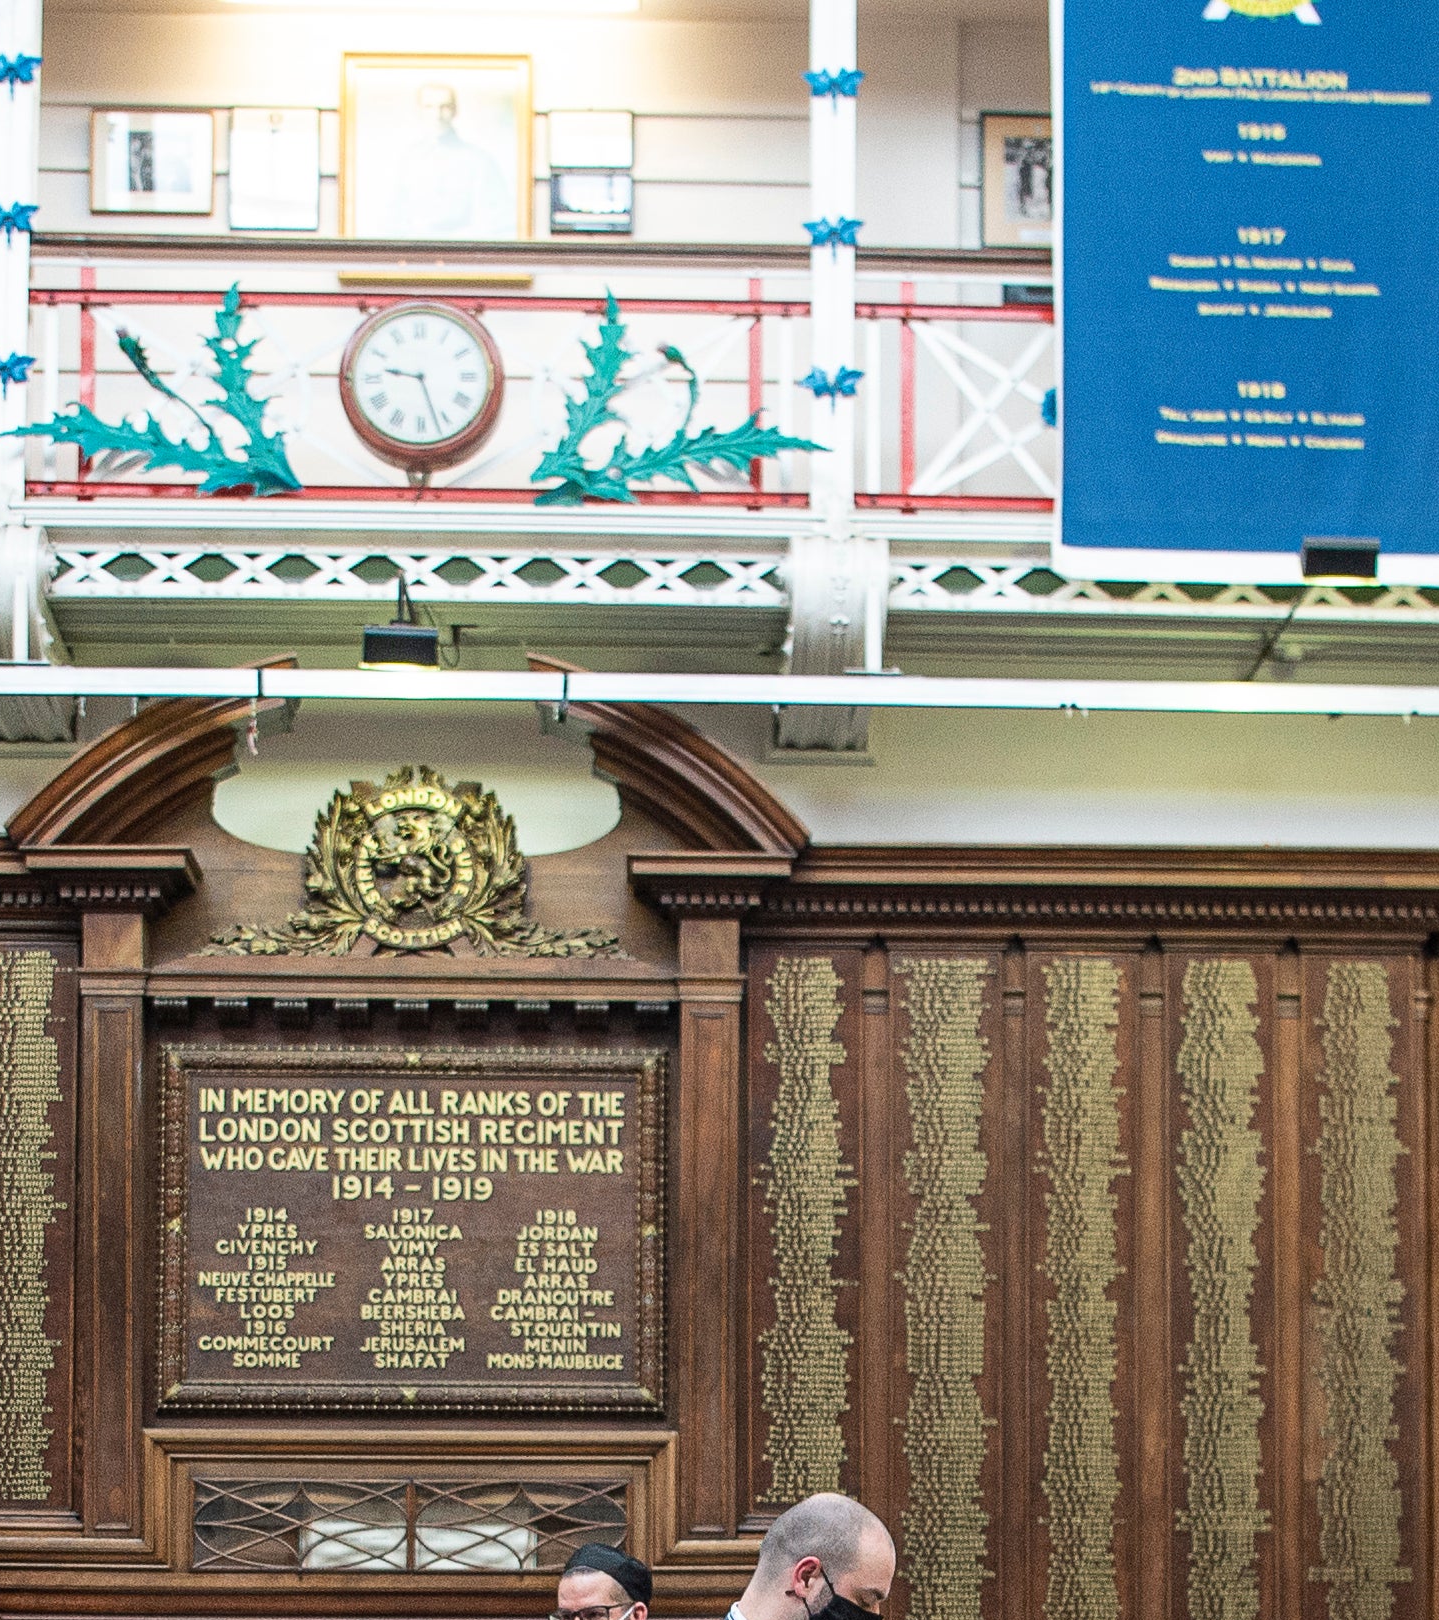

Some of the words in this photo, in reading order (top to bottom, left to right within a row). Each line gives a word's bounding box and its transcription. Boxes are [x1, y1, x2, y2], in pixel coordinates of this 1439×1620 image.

[366, 788, 463, 817] LONDON
[365, 919, 463, 946] SCOTTISH
[199, 1090, 226, 1114] IN
[233, 1090, 344, 1114] MEMORY
[349, 1090, 383, 1115] OF
[389, 1091, 434, 1115] ALL
[444, 1091, 530, 1116] RANKS
[536, 1092, 570, 1116] OF
[579, 1092, 625, 1117] THE
[199, 1119, 321, 1142] LONDON
[332, 1119, 470, 1144] SCOTTISH
[479, 1120, 624, 1145] REGIMENT
[201, 1148, 262, 1171] WHO
[268, 1148, 329, 1171] GAVE
[335, 1148, 401, 1171] THEIR
[408, 1149, 476, 1172] LIVES
[482, 1149, 511, 1172] IN
[518, 1149, 558, 1173] THE
[567, 1150, 623, 1174] WAR
[332, 1176, 395, 1199] 1914
[432, 1176, 494, 1200] 1919
[246, 1208, 288, 1223] 1914
[392, 1208, 433, 1224] 1917
[536, 1209, 577, 1225] 1918
[237, 1224, 298, 1239] YPRES
[364, 1224, 463, 1240] SALONICA
[516, 1226, 598, 1242] JORDAN
[216, 1239, 318, 1255] GIVENCHY
[388, 1241, 439, 1256] VIMY
[518, 1242, 540, 1258] ES
[546, 1242, 593, 1258] SALT
[247, 1255, 287, 1271] 1915
[381, 1257, 446, 1273] ARRAS
[515, 1258, 537, 1274] EL
[544, 1258, 598, 1274] HAUD
[199, 1272, 250, 1287] NEUVE
[253, 1272, 336, 1287] CHAPPELLE
[383, 1273, 444, 1289] YPRES
[524, 1274, 589, 1290] ARRAS
[216, 1288, 318, 1303] FESTUBERT
[368, 1289, 458, 1304] CAMBRAI
[498, 1289, 615, 1307] DRANOUTRE
[240, 1304, 296, 1319] LOOS
[360, 1305, 466, 1321] BEERSHEBA
[490, 1306, 580, 1321] CAMBRAI
[246, 1321, 286, 1335] 1916
[380, 1321, 446, 1336] SHERIA
[511, 1323, 621, 1339] ST.QUENTIN
[199, 1336, 335, 1352] GOMMECOURT
[360, 1337, 465, 1352] JERUSALEM
[524, 1339, 587, 1353] MENIN
[233, 1352, 301, 1368] SOMME
[375, 1353, 450, 1369] SHAFAT
